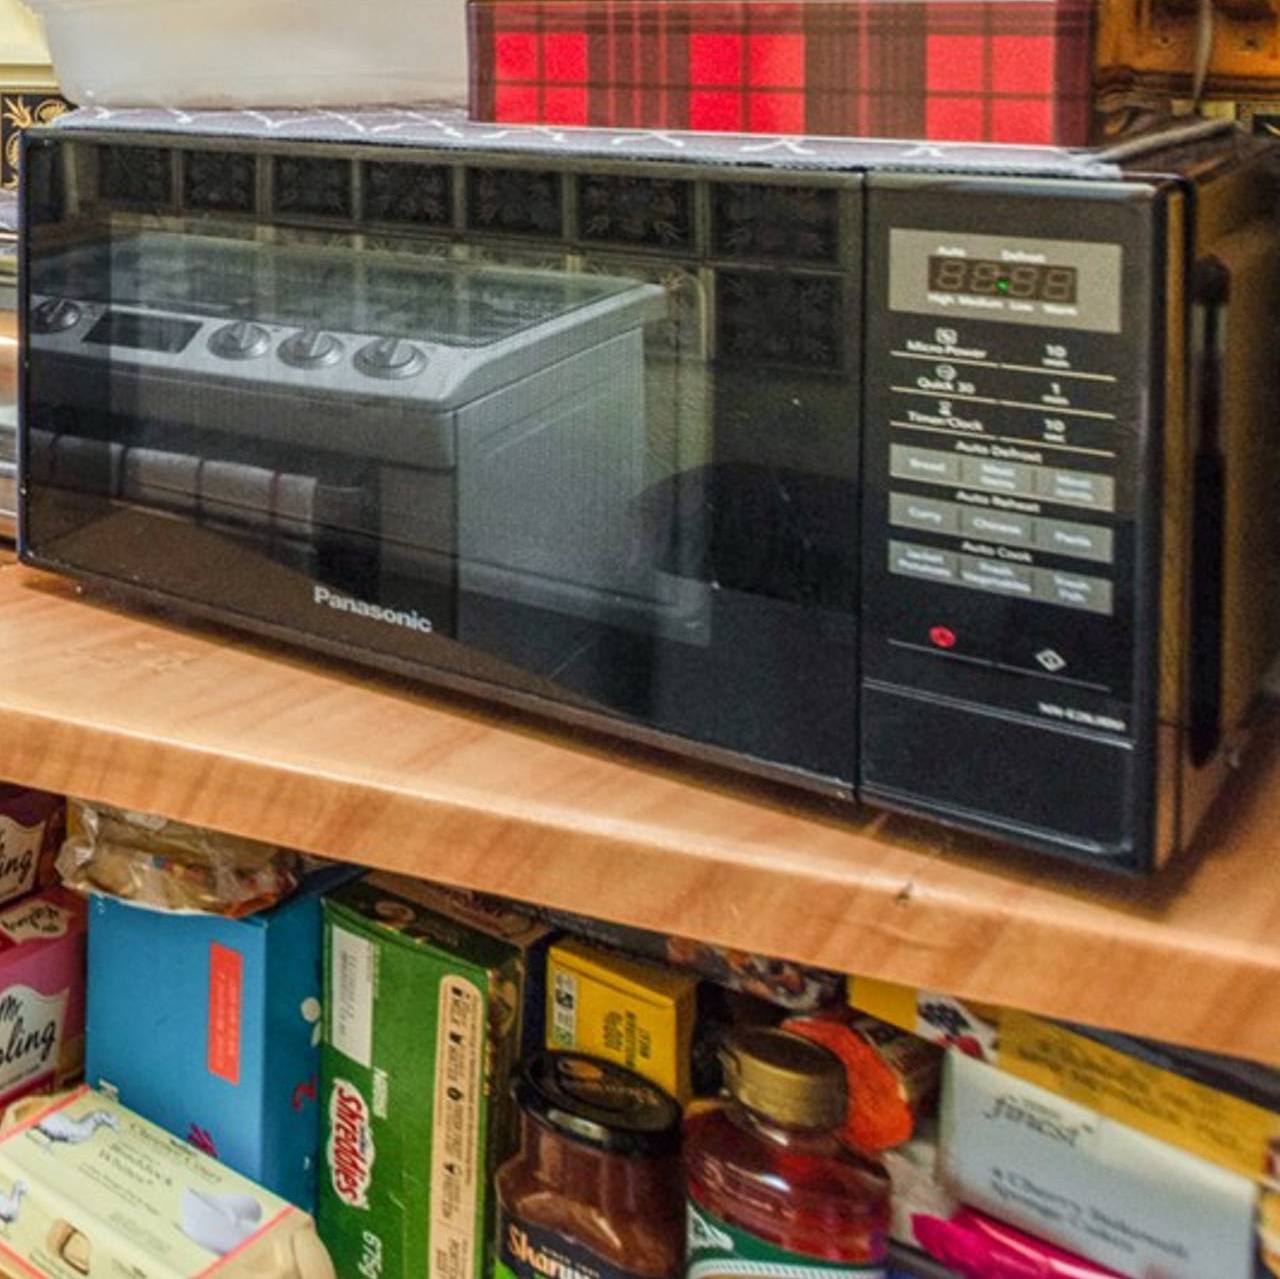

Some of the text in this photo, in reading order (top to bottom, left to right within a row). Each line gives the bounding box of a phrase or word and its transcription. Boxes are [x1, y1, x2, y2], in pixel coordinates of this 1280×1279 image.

[997, 546, 1032, 563] Cook
[314, 585, 433, 633] Panasonic
[334, 1087, 368, 1201] Shreddies
